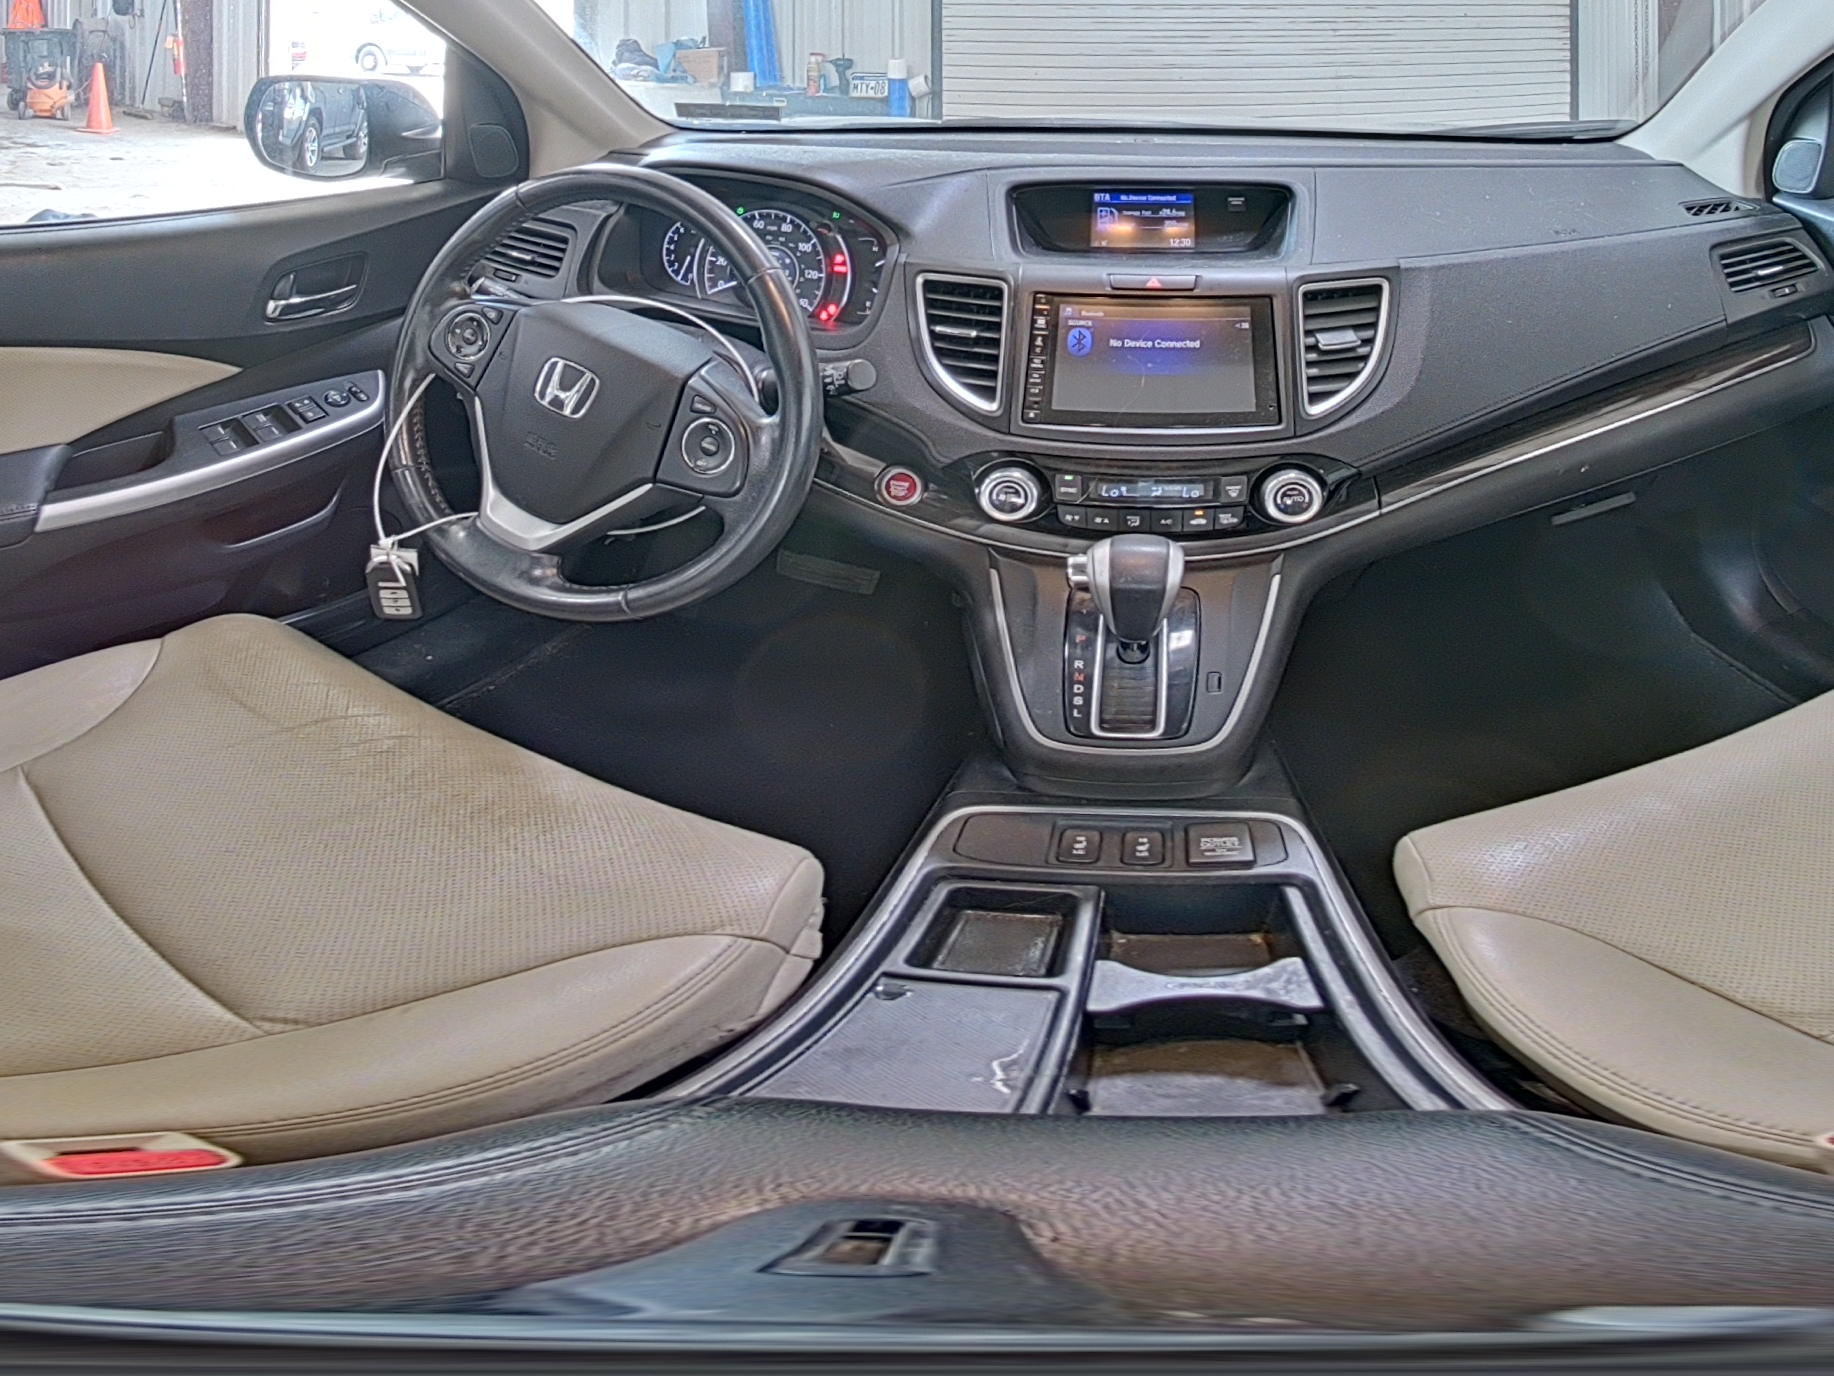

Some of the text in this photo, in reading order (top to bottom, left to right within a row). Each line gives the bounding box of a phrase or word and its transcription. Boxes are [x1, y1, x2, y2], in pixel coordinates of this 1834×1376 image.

[753, 220, 765, 229] 60
[781, 224, 793, 233] 80
[798, 243, 812, 252] 100
[715, 256, 727, 266] 20
[805, 270, 818, 279] 120
[1109, 338, 1201, 348] No Device Connected
[1282, 495, 1305, 503] AUTO
[1074, 660, 1084, 669] R
[1073, 684, 1084, 693] D
[1073, 696, 1083, 705] S
[1073, 708, 1082, 717] L
